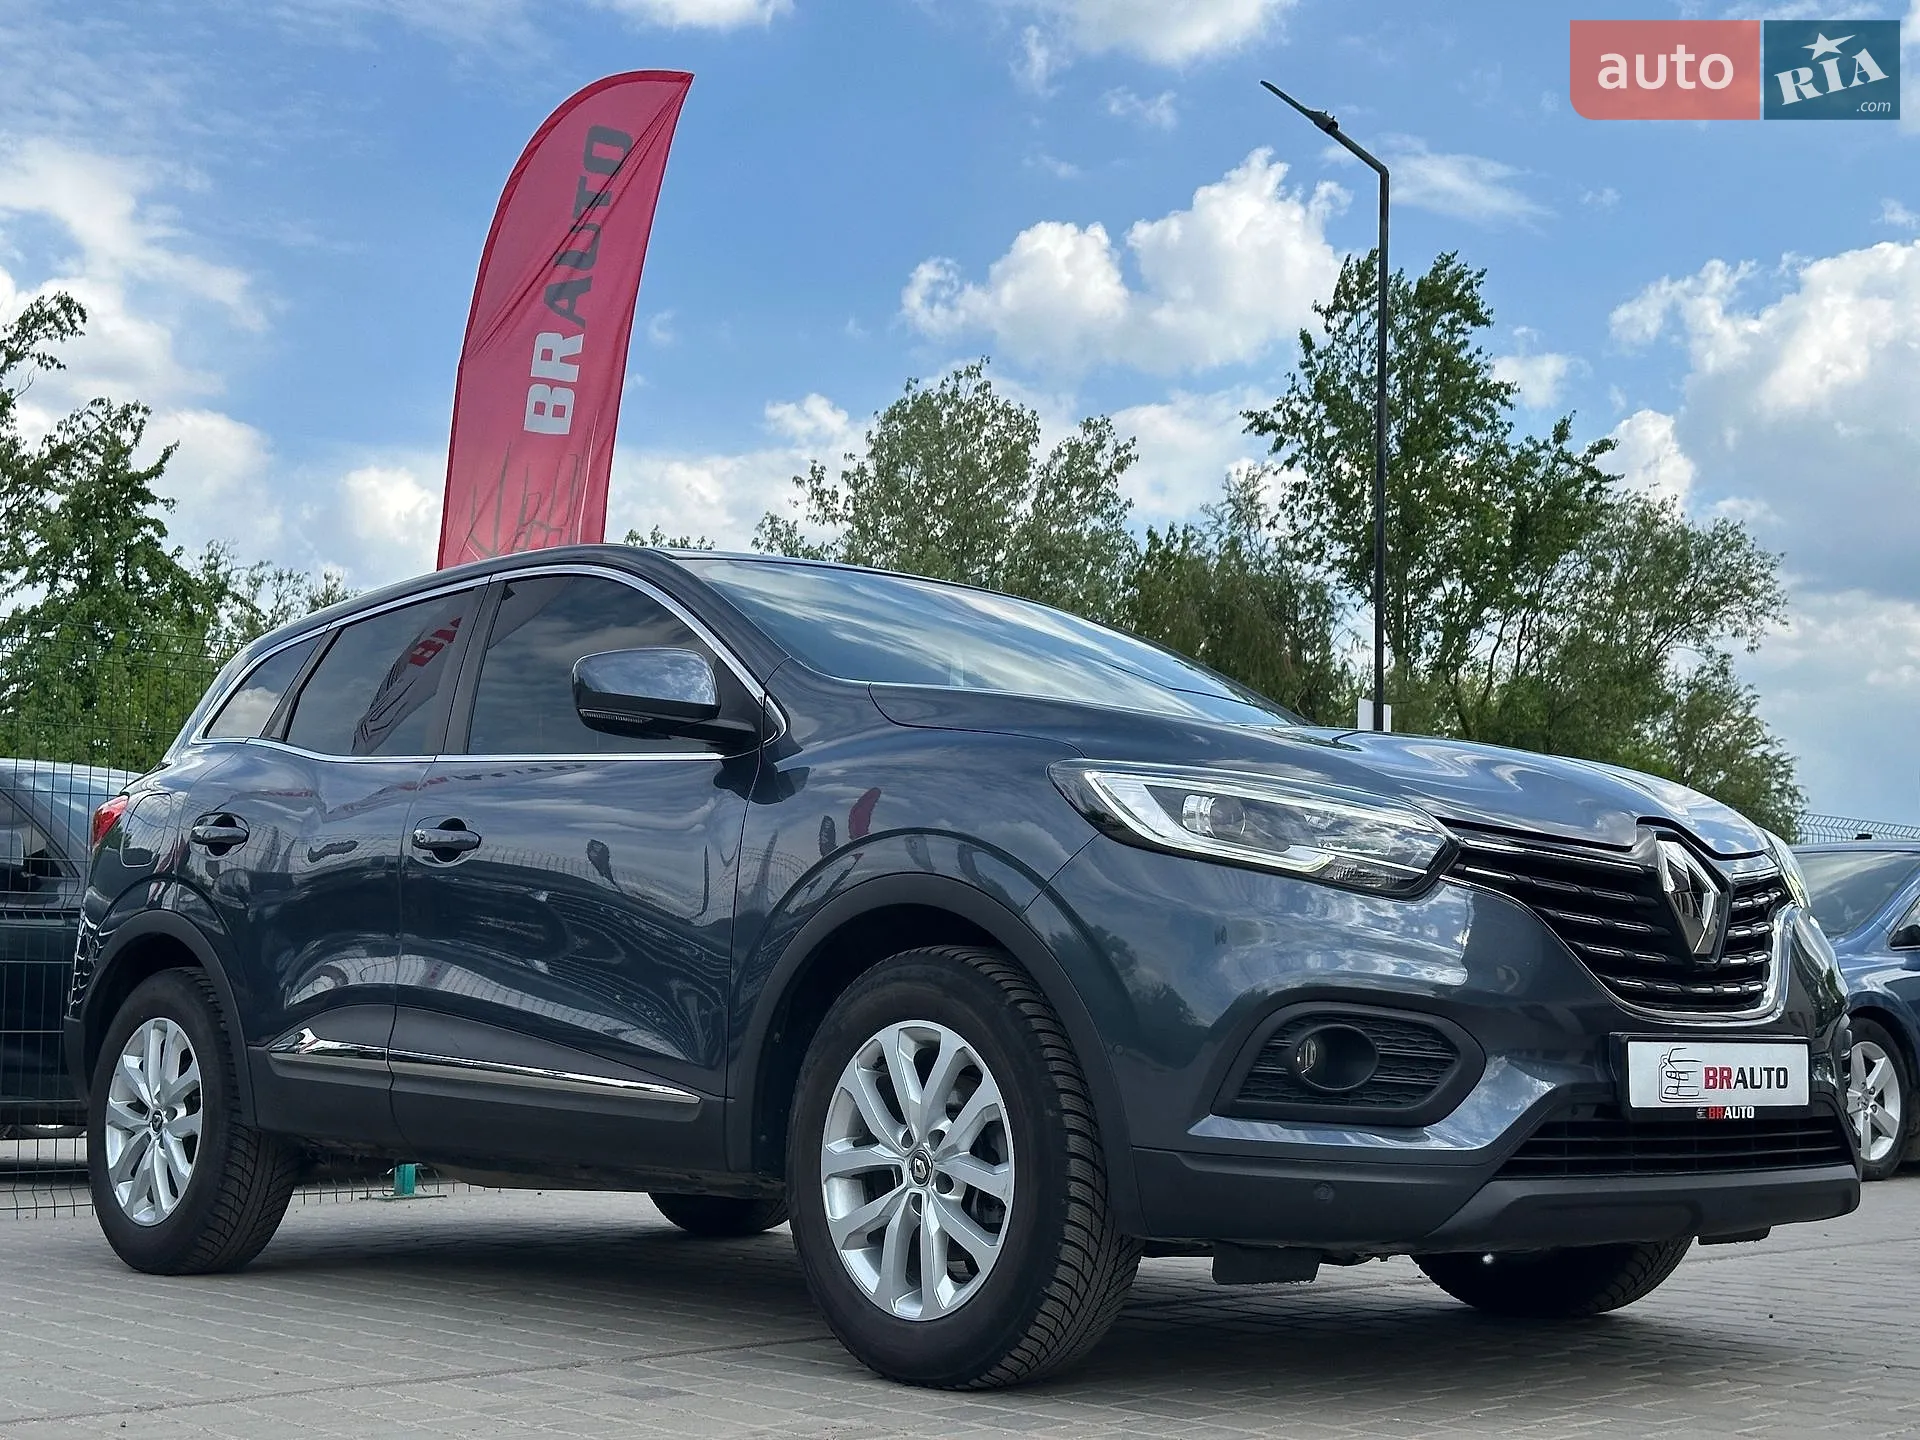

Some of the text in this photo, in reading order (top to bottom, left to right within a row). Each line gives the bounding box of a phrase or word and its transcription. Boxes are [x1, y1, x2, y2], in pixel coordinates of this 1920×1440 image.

[524, 125, 634, 435] BRAUTO
[1704, 1066, 1788, 1089] BRAUTO
[1708, 1106, 1755, 1119] BRAUTO
